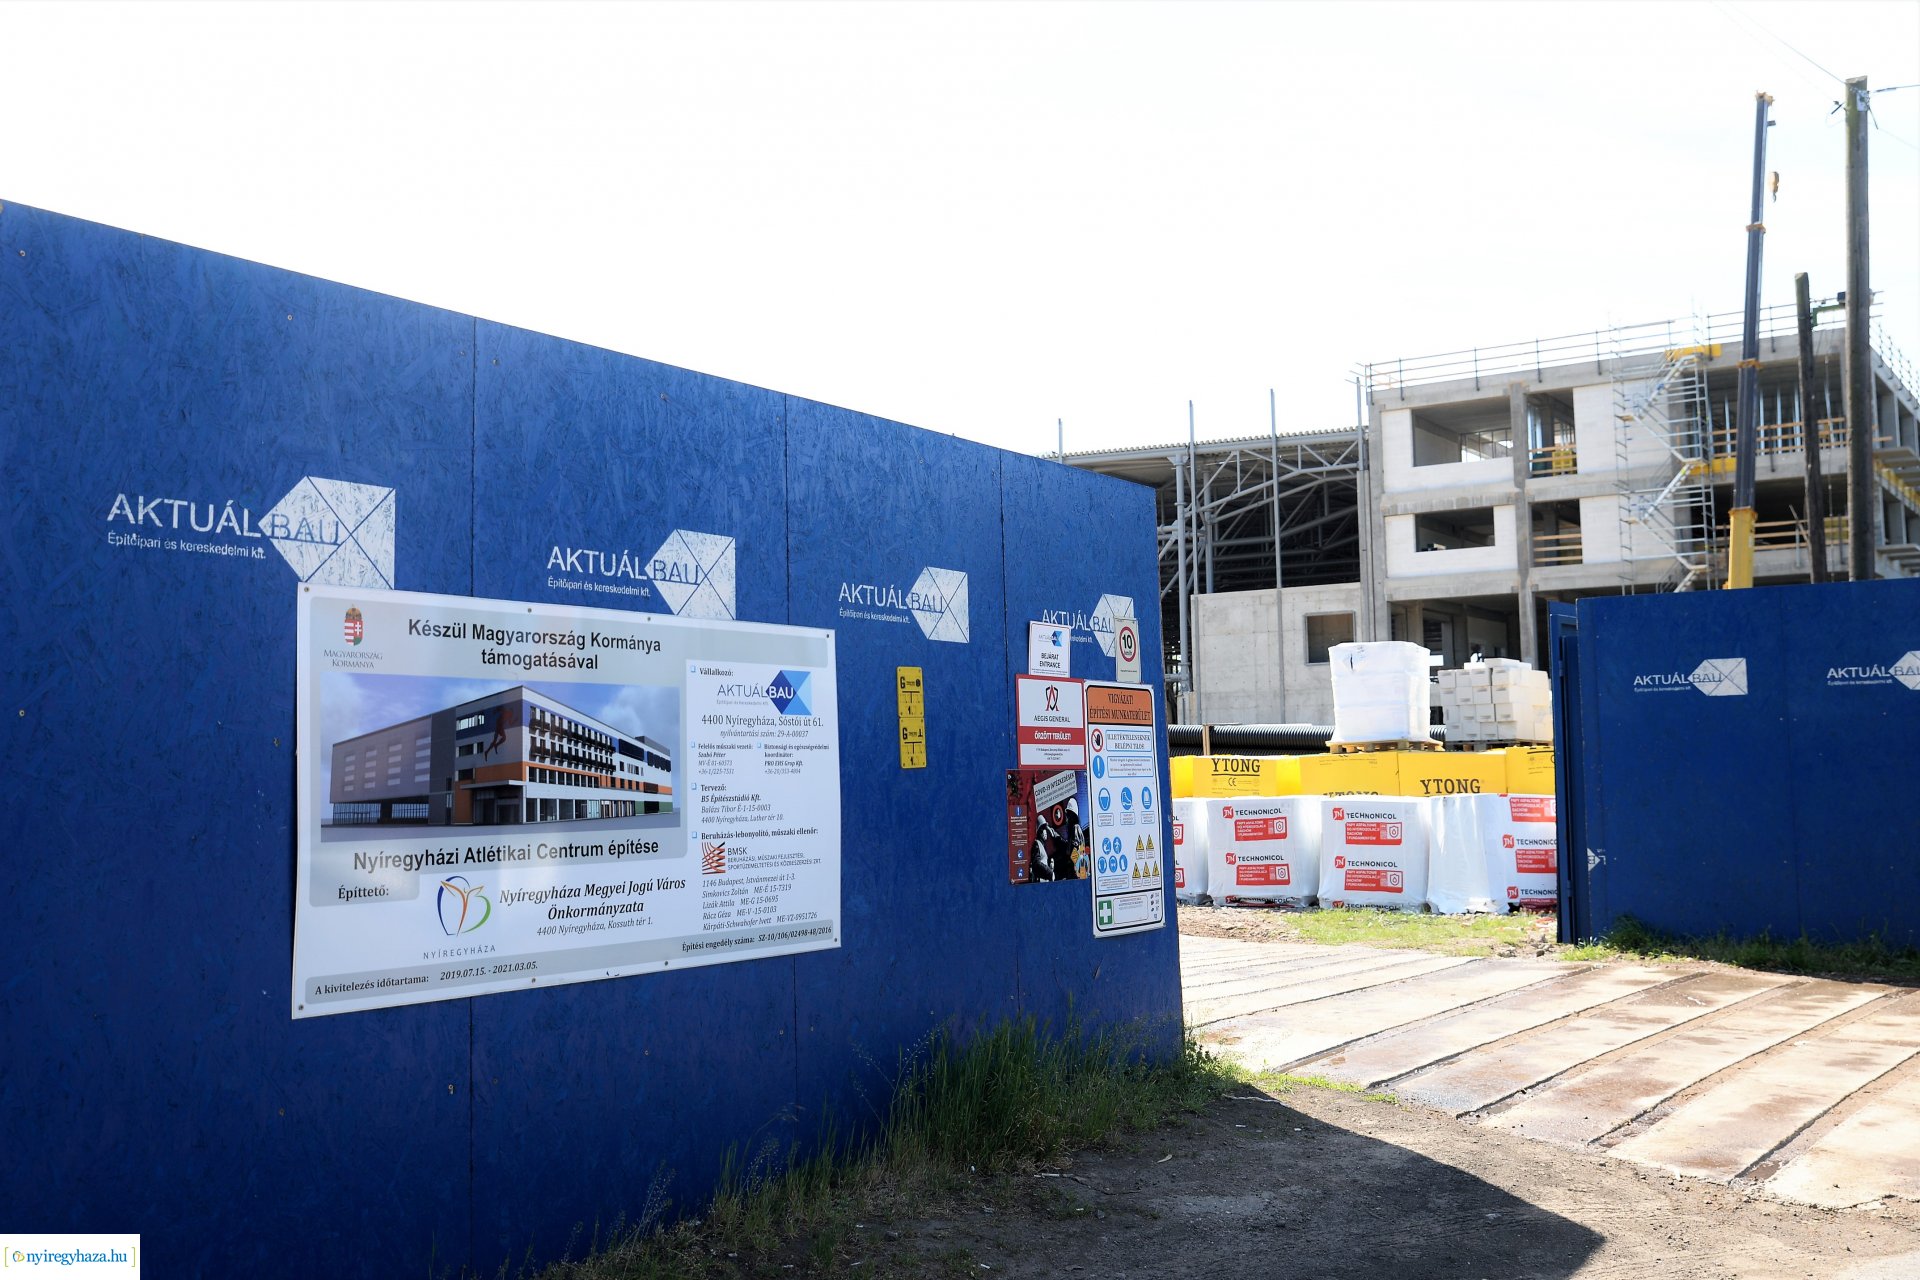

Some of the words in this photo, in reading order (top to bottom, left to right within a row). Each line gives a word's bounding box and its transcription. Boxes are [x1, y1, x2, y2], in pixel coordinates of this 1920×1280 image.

[164, 539, 178, 549] és
[180, 539, 249, 557] kereskedelmi
[584, 581, 593, 591] és
[594, 583, 639, 596] kereskedelmi
[409, 619, 466, 640] Készül
[472, 623, 585, 650] Magyarország
[591, 632, 661, 654] Kormánya
[1122, 634, 1133, 649] 10
[481, 648, 598, 670] támogatásával
[1041, 652, 1059, 660] BEJÁRAT
[1039, 660, 1061, 669] ENTRANCE
[700, 668, 734, 677] Vállalkozó:
[702, 715, 723, 725] 4400
[726, 715, 777, 728] Nyíregyháza,
[779, 716, 801, 726] Sóstói
[804, 717, 811, 727] út
[813, 718, 823, 727] 61.
[720, 730, 759, 739] nyilvántartási
[1211, 758, 1260, 773] YTONG
[1420, 778, 1481, 794] YTONG
[721, 805, 736, 813] Tibor
[1235, 808, 1282, 816] TECHNONICOL
[1346, 812, 1397, 820] TECHNONICOL
[772, 828, 796, 837] műszaki
[796, 827, 818, 835] ellenőr:
[353, 850, 459, 874] Nyíregyházi
[464, 844, 531, 865] Atlétikai
[536, 842, 604, 860] Centrum
[608, 839, 659, 859] építése
[727, 847, 748, 855] BMSK
[1238, 854, 1284, 862] TECHNONICOL
[1347, 860, 1398, 868] TECHNONICOL
[702, 879, 717, 888] 1146
[338, 884, 389, 901] Építtető:
[499, 886, 581, 906] Nyíregyháza
[583, 881, 626, 899] Megyei
[627, 879, 653, 896] Jogú
[656, 877, 686, 891] Város
[548, 901, 644, 920] Önkormányzata
[536, 925, 557, 936] 4400
[558, 921, 606, 936] Nyíregyháza,
[607, 918, 634, 930] Kossuth
[635, 917, 646, 926] tér
[647, 917, 653, 925] 1.
[423, 944, 497, 960] NYÍREGYHÁZA
[682, 942, 704, 953] Építési
[705, 938, 733, 949] engedély
[734, 936, 755, 946] száma:
[315, 986, 323, 995] A
[324, 979, 375, 994] kivitelezés
[376, 975, 430, 989] időtartama:
[440, 967, 487, 981] 2019.07.15.
[492, 961, 538, 974] 2021.03.05.
